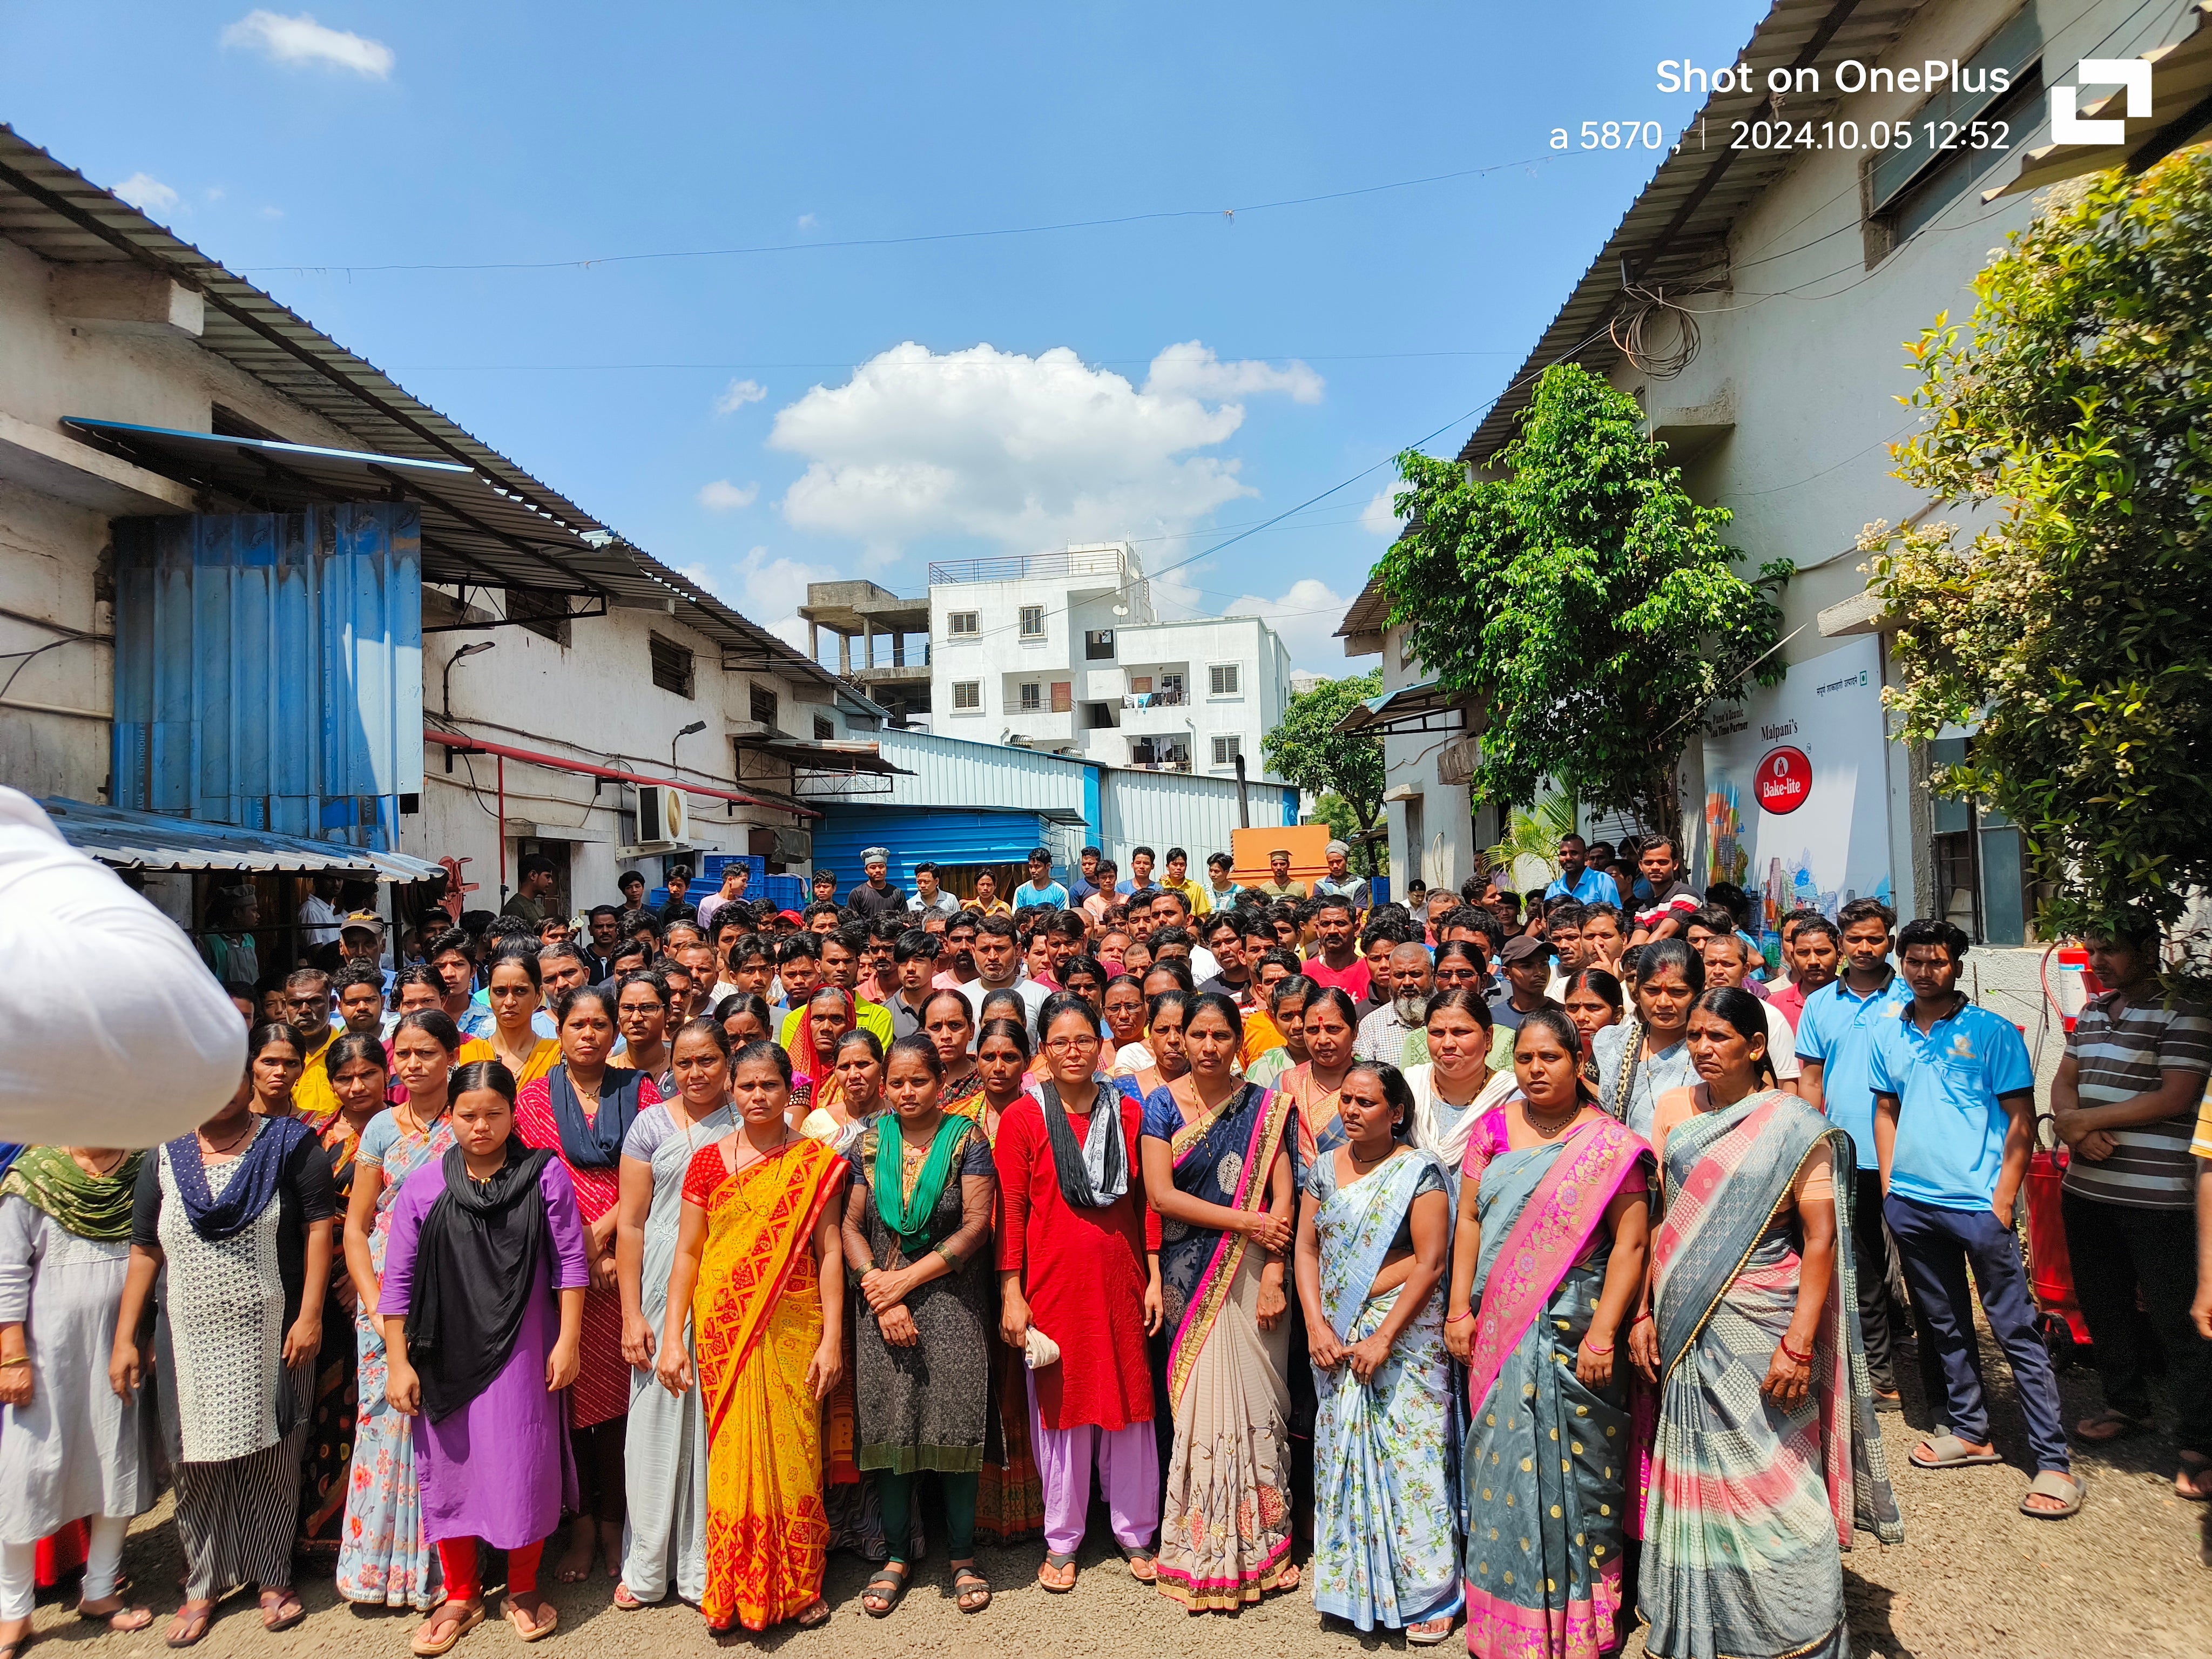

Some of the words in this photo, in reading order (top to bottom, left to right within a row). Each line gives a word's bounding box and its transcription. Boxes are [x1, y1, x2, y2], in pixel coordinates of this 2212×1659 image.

[1713, 711, 1728, 725] Pune's
[1729, 708, 1743, 720] Iconic
[1718, 726, 1729, 736] Time
[1730, 721, 1748, 733] Partner
[1761, 718, 1798, 742] Malpani's
[1763, 778, 1801, 798] Bake-lite
